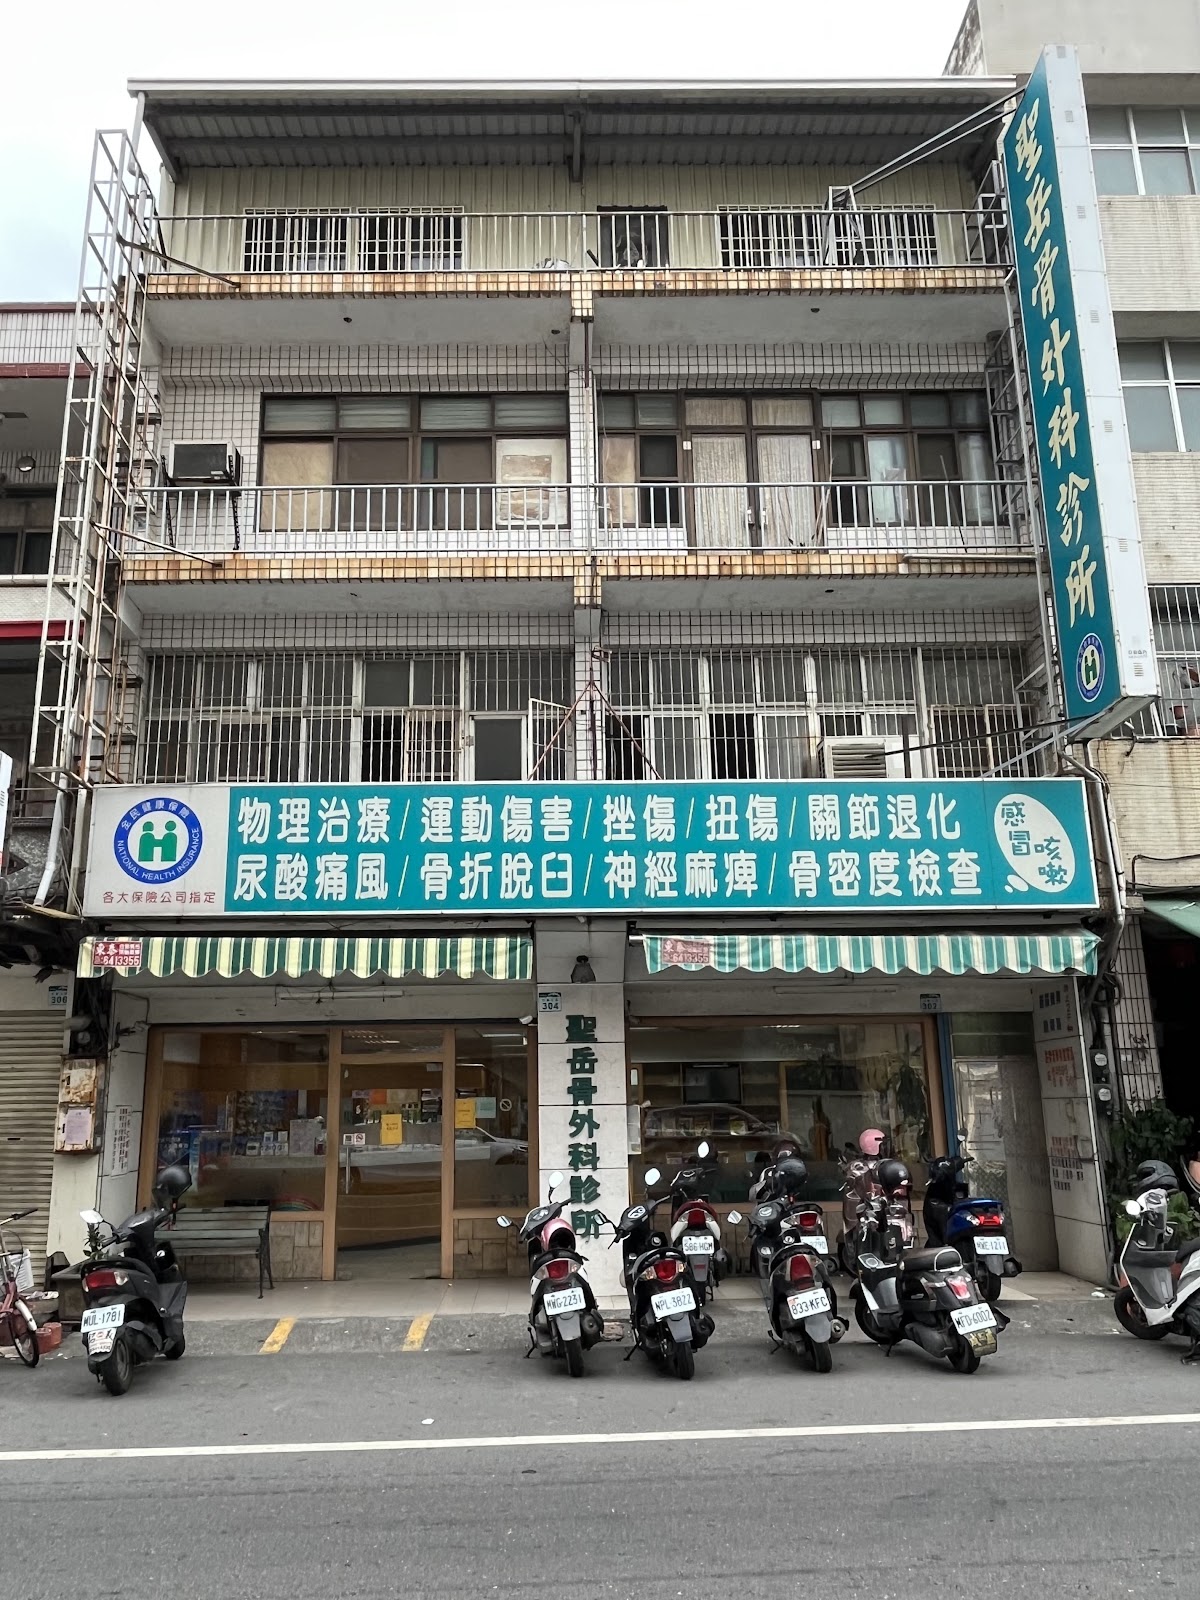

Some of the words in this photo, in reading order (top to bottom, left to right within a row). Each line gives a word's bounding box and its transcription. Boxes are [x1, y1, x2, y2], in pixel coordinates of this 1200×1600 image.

[1015, 97, 1097, 628] 聖岳骨外科診所
[121, 799, 190, 831] 全民健康保險
[1001, 801, 1031, 856] 感冒
[117, 840, 140, 876] NATIONAL
[141, 870, 176, 881] HEALTH
[176, 827, 200, 873] INSURANCE
[1034, 836, 1068, 886] 咳嗽
[102, 891, 216, 904] 各大保險公司指定
[542, 1002, 559, 1010] 304
[566, 1014, 602, 1241] 聖岳骨外科診所
[546, 1293, 582, 1310] MWG-2231
[655, 1293, 693, 1311] NPL-3822
[791, 1295, 829, 1316] 833-KFC
[83, 1310, 121, 1327] MUL-1781
[955, 1309, 993, 1329] MFD-6002
